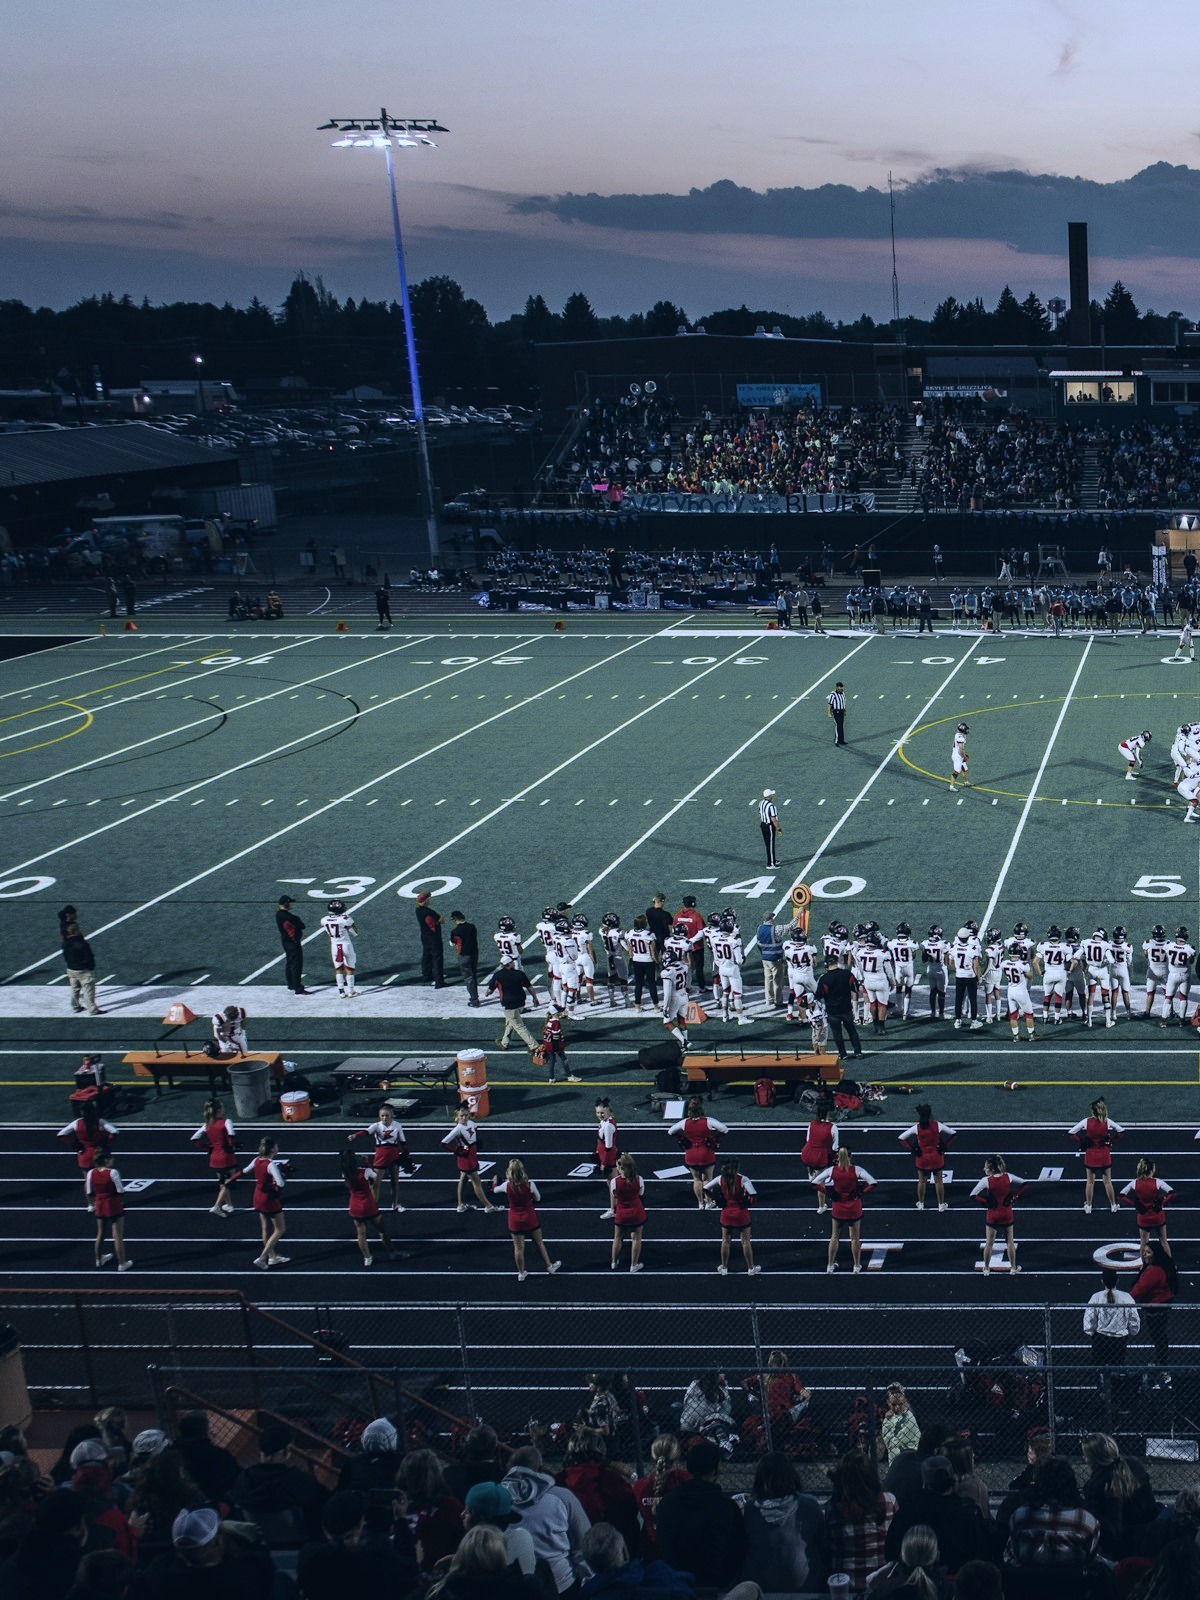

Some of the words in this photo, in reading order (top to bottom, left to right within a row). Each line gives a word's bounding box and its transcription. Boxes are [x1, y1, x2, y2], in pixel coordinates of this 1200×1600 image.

[785, 494, 860, 514] BLUE
[307, 876, 463, 898] 30
[718, 876, 867, 898] 40
[326, 924, 340, 938] 17
[715, 944, 732, 960] 50
[792, 952, 810, 967] 44
[894, 948, 909, 962] 19
[1045, 950, 1063, 965] 74
[1087, 946, 1102, 962] 10
[1169, 951, 1188, 966] 79
[860, 956, 878, 972] 77
[958, 954, 966, 968] 7
[1004, 968, 1020, 984] 56
[170, 1006, 184, 1021] 30
